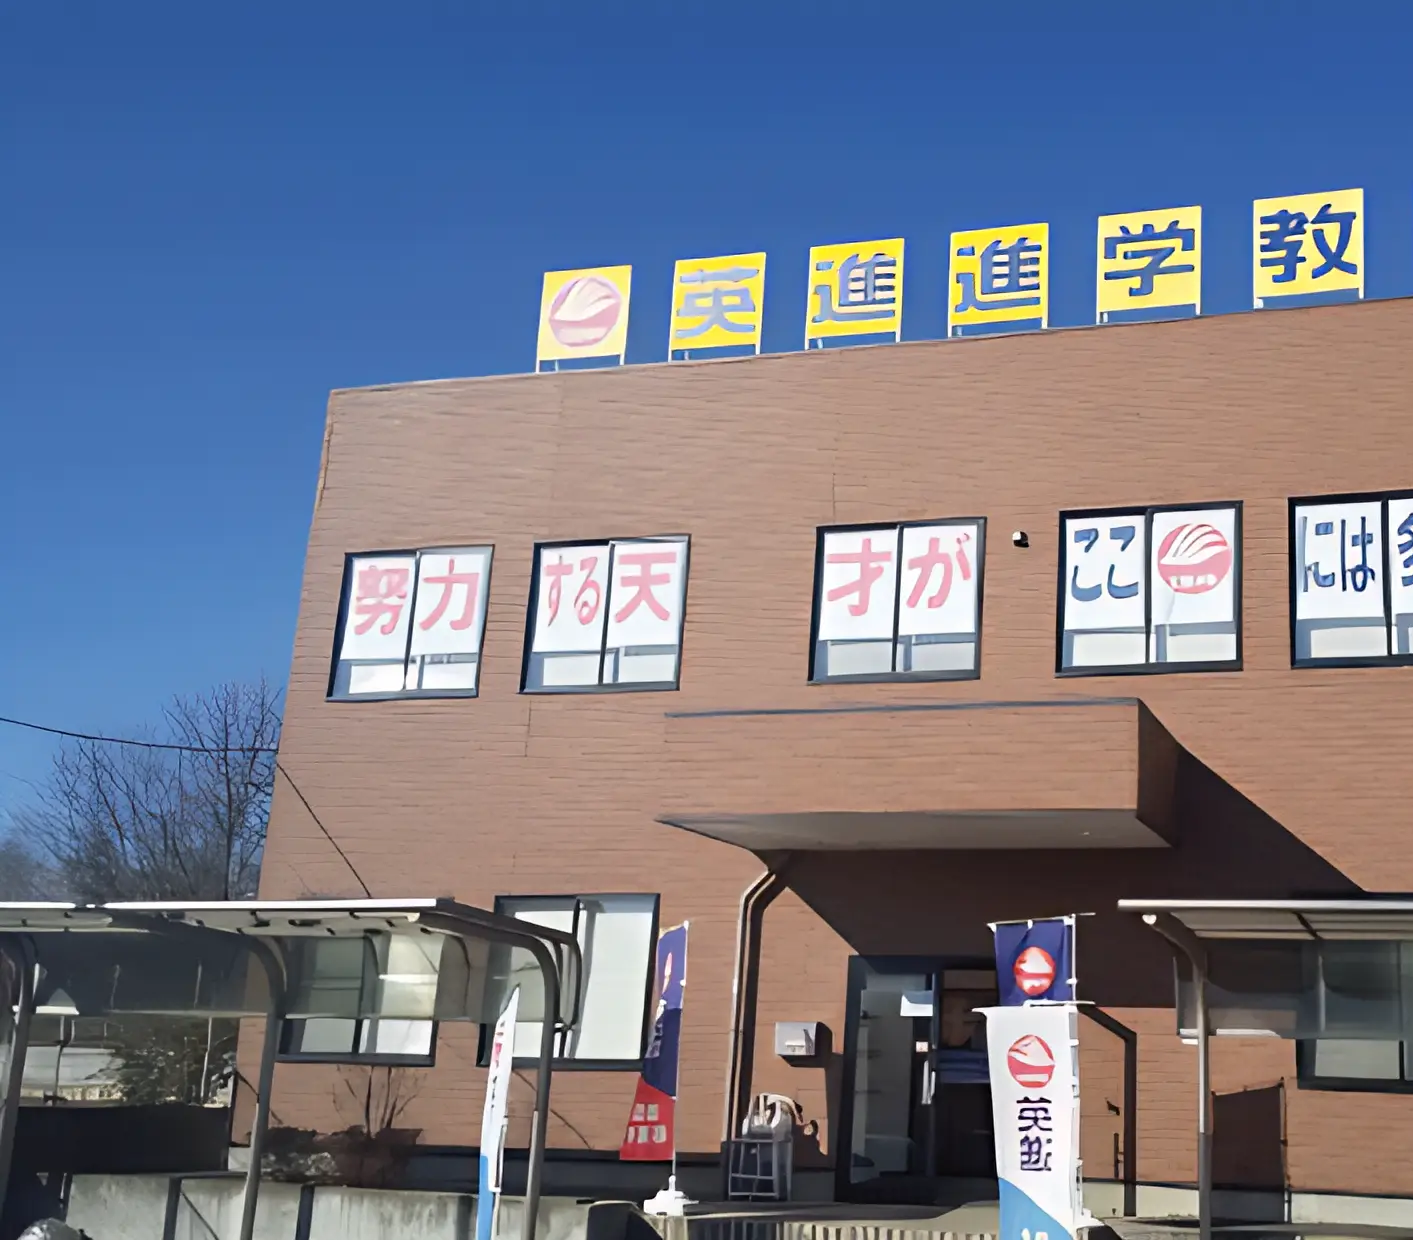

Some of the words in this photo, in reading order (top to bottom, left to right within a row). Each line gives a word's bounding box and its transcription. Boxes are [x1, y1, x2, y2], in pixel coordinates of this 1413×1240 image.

[353, 558, 480, 636] 努力
[543, 552, 678, 627] する天
[825, 531, 972, 618] 才が
[1070, 525, 1140, 602] ここ
